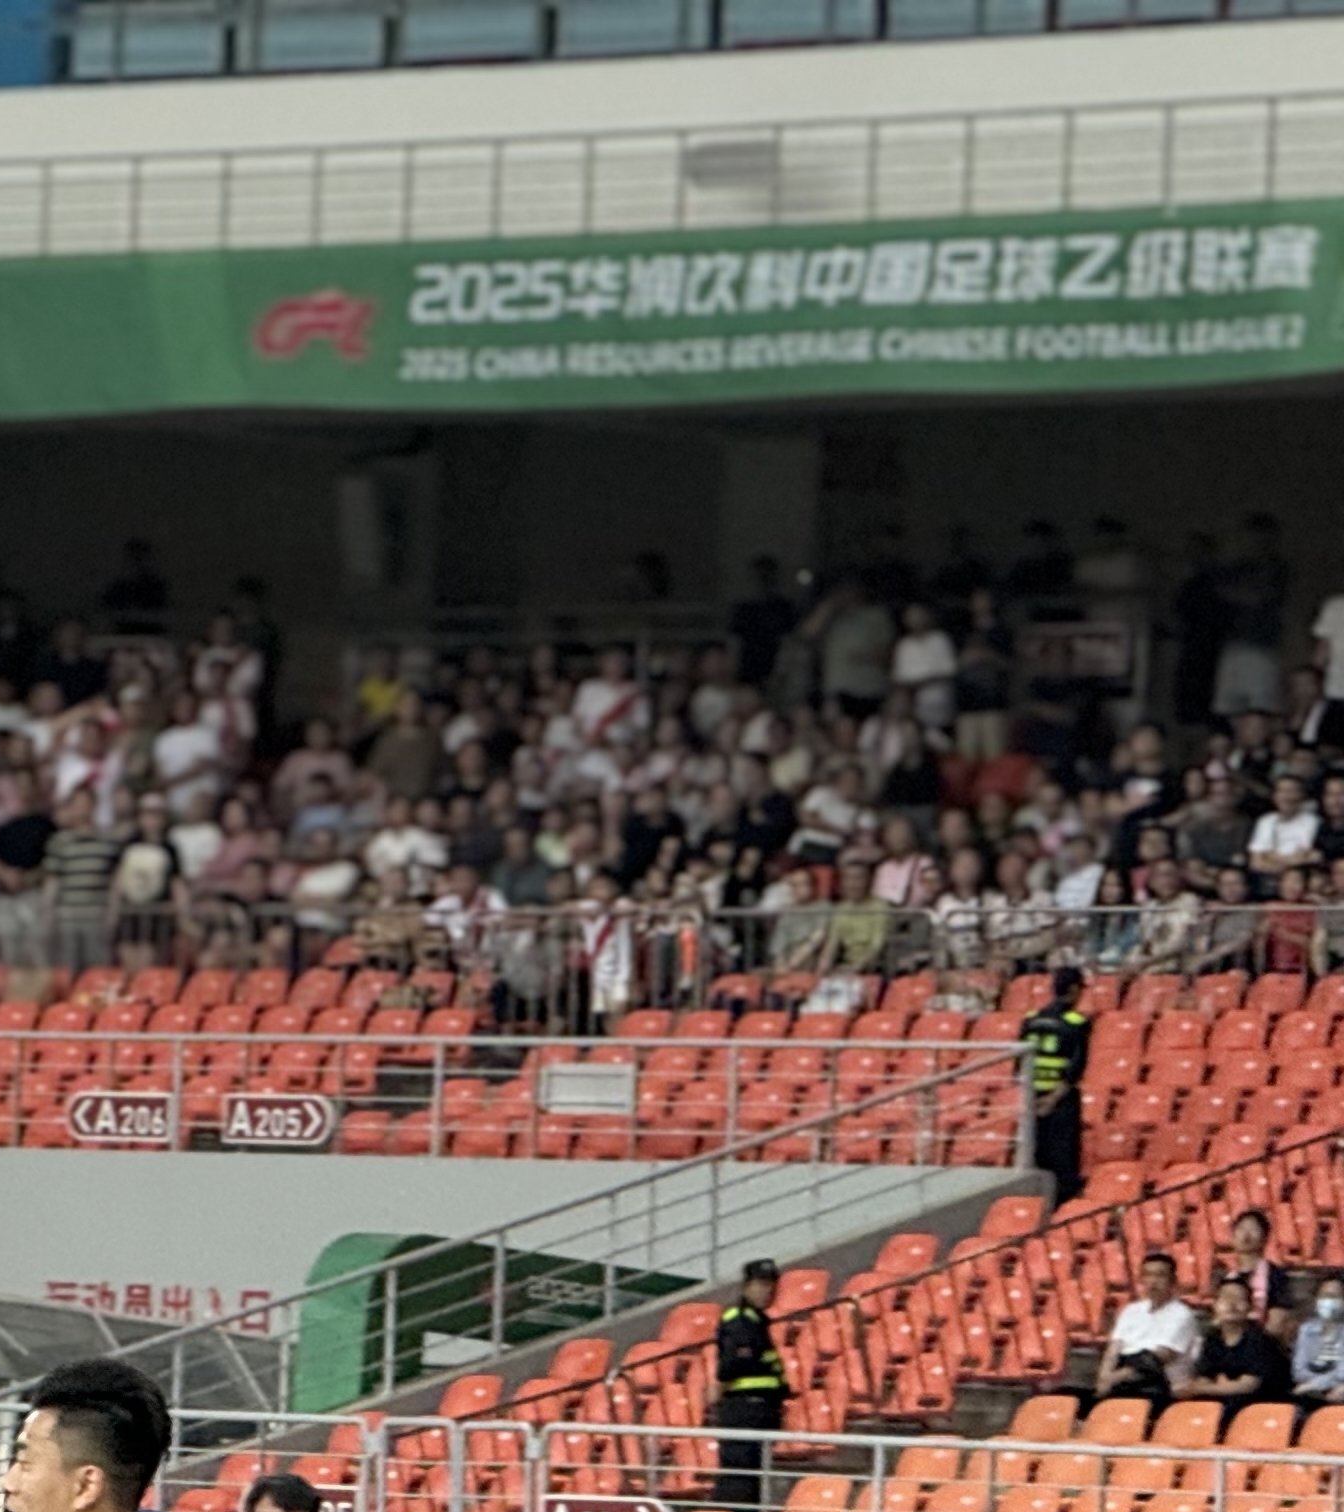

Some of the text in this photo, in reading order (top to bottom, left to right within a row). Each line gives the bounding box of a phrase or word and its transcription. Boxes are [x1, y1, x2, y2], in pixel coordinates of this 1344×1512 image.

[474, 345, 559, 379] CHINA
[881, 324, 1010, 361] CHINESE
[1015, 319, 1169, 359] FOOTBALL
[93, 1100, 165, 1135] A206
[228, 1100, 302, 1138] A205
